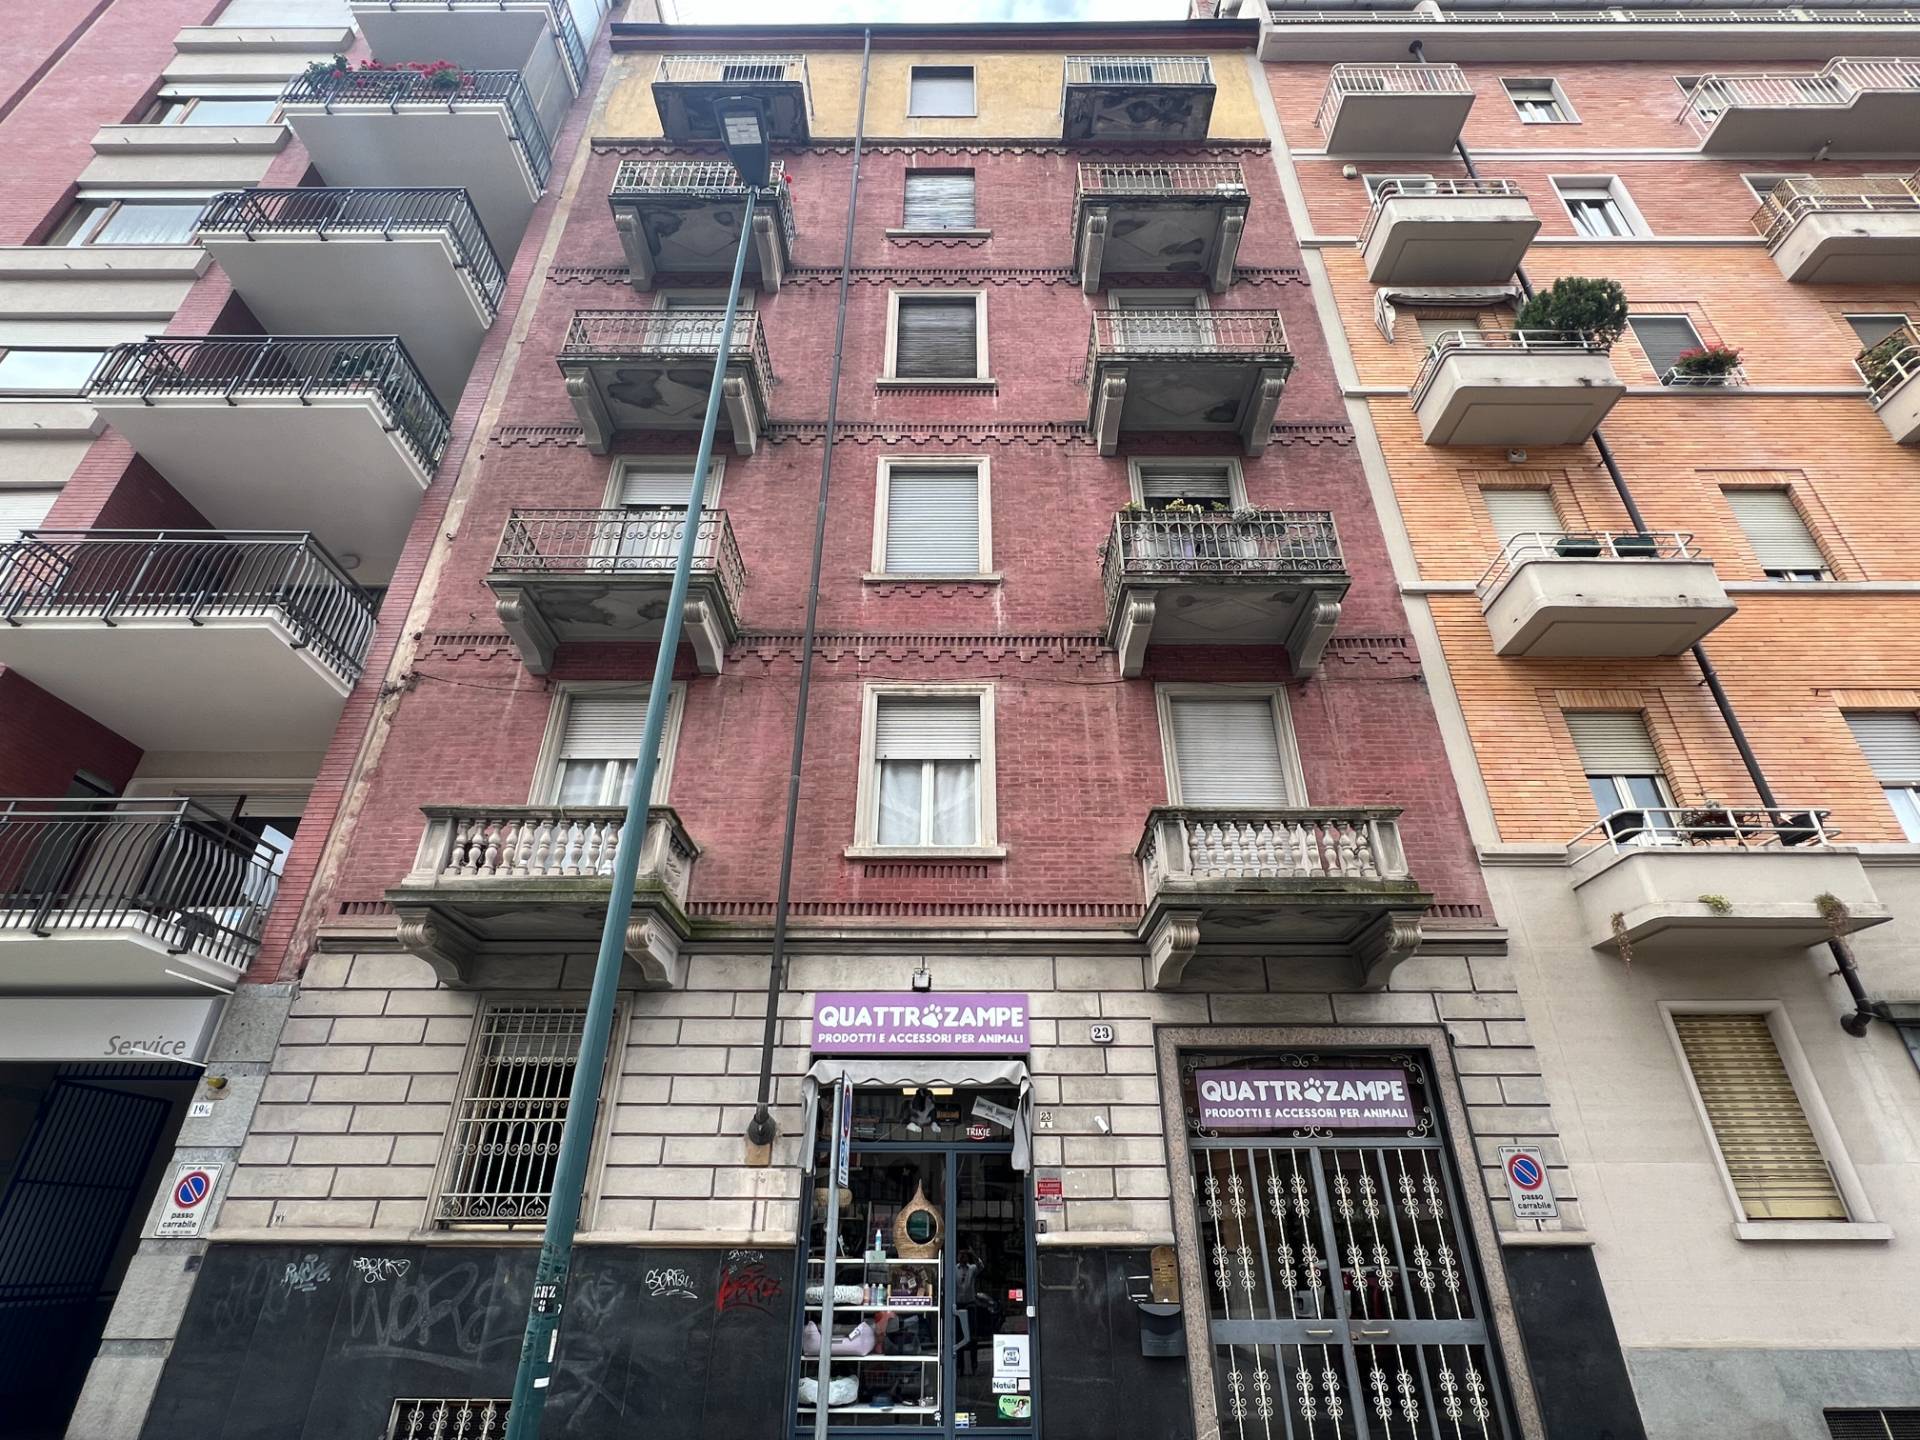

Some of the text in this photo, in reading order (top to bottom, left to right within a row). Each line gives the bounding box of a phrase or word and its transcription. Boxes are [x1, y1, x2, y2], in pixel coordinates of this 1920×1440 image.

[1093, 1027, 1109, 1039] 23
[818, 1033, 1024, 1044] PRODOTTI E ACCESSORI PER ANIMALI
[103, 1035, 186, 1056] Service
[1041, 1111, 1052, 1121] 23
[1205, 1108, 1408, 1118] PRODOTTI E ACCESSORI PER ANIMALI
[966, 1127, 991, 1136] TRIXIE
[162, 1221, 197, 1229] carrabile
